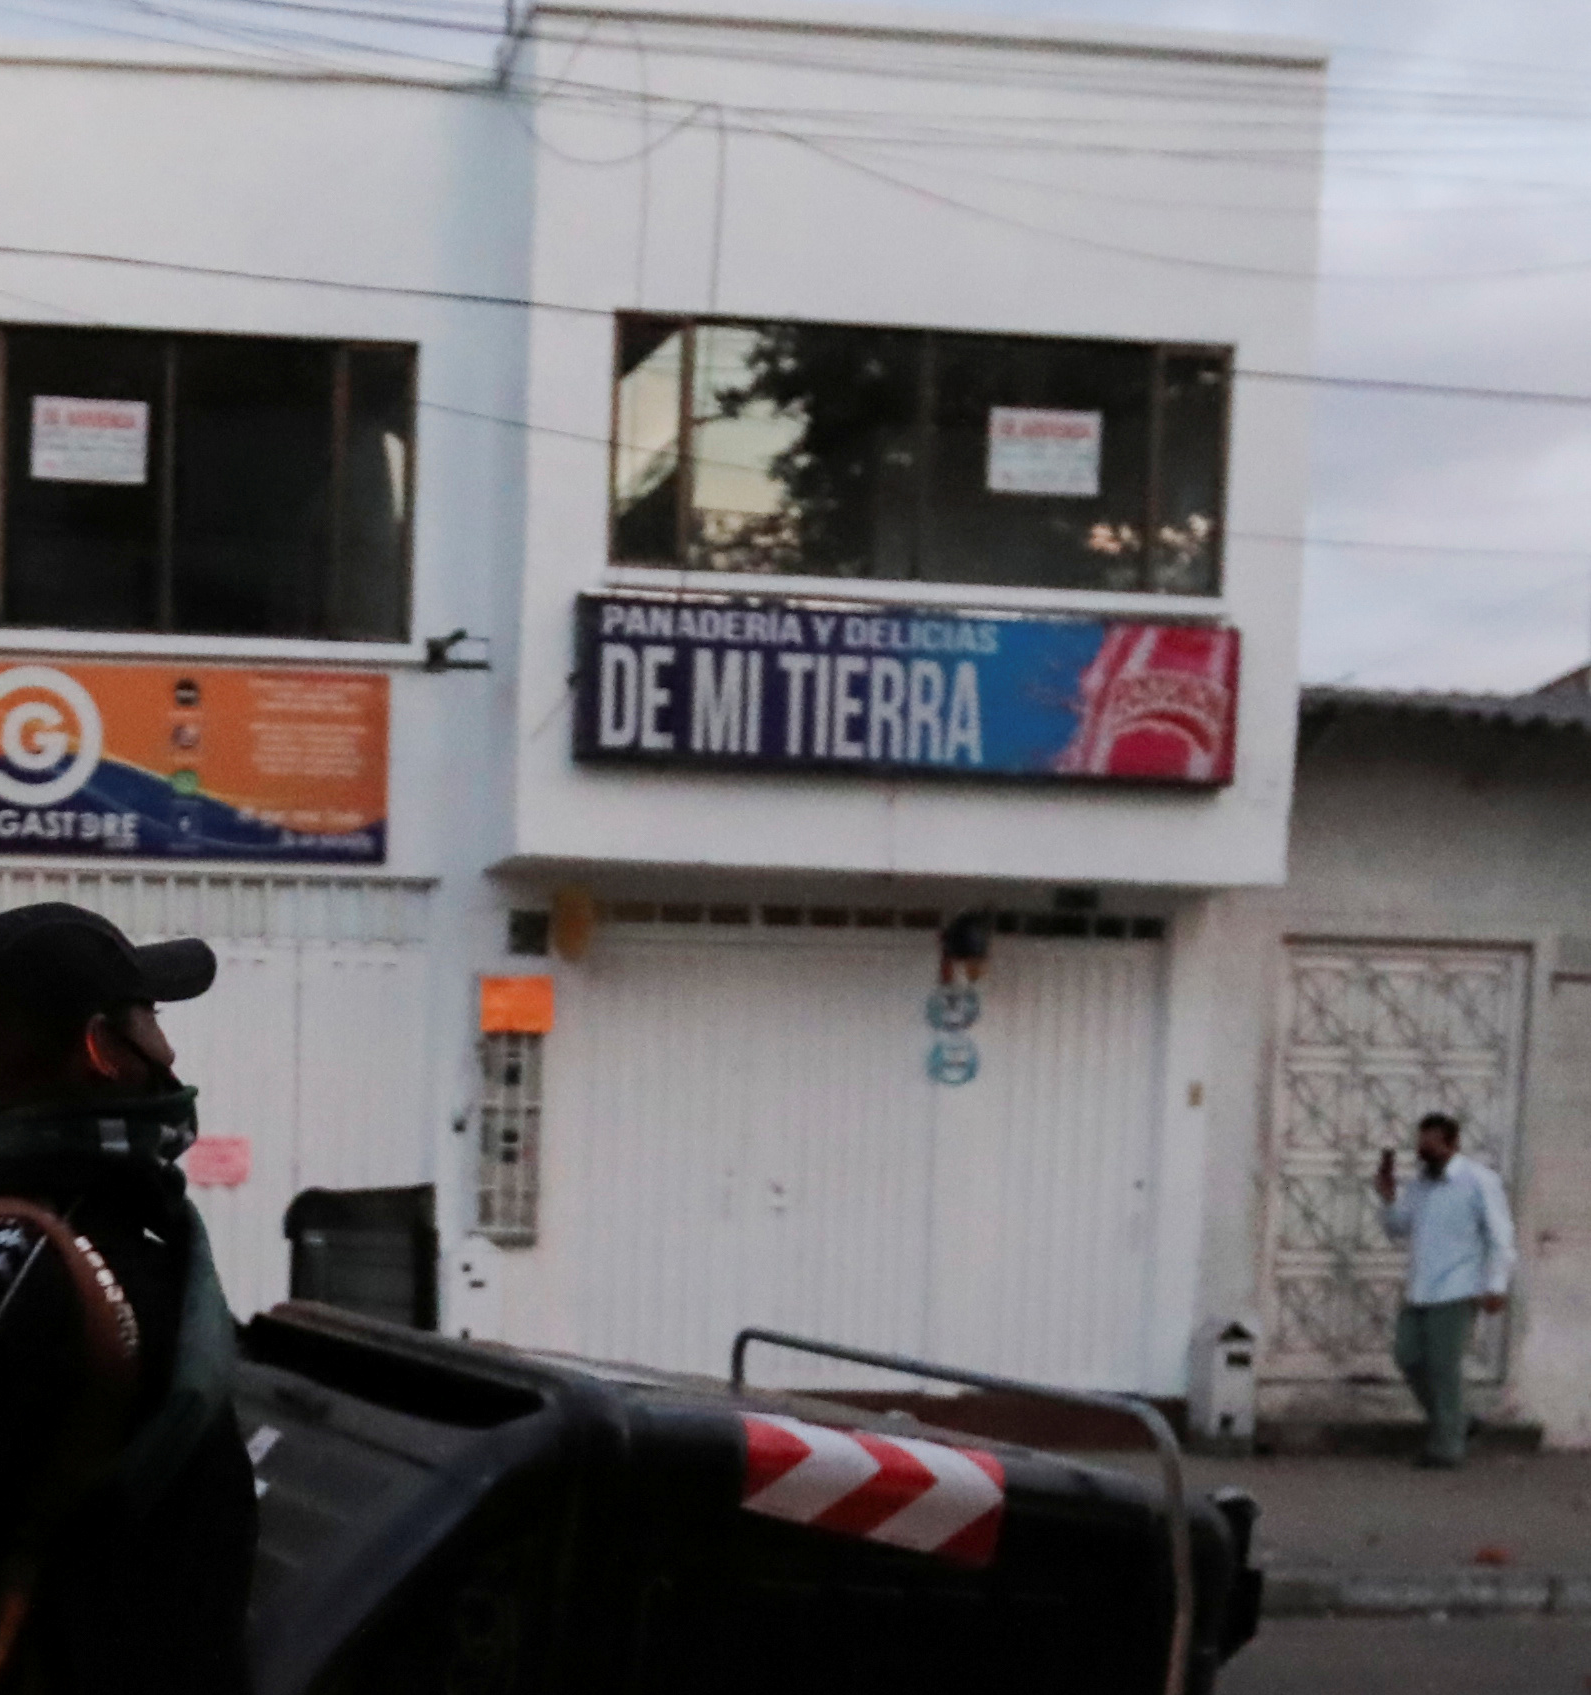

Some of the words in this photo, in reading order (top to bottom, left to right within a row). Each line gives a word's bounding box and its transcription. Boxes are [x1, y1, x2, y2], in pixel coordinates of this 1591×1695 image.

[810, 615, 837, 646] Y
[843, 616, 998, 654] DELICIAS
[598, 643, 675, 749] DE
[689, 648, 765, 755] MI
[776, 653, 985, 765] TIERRA
